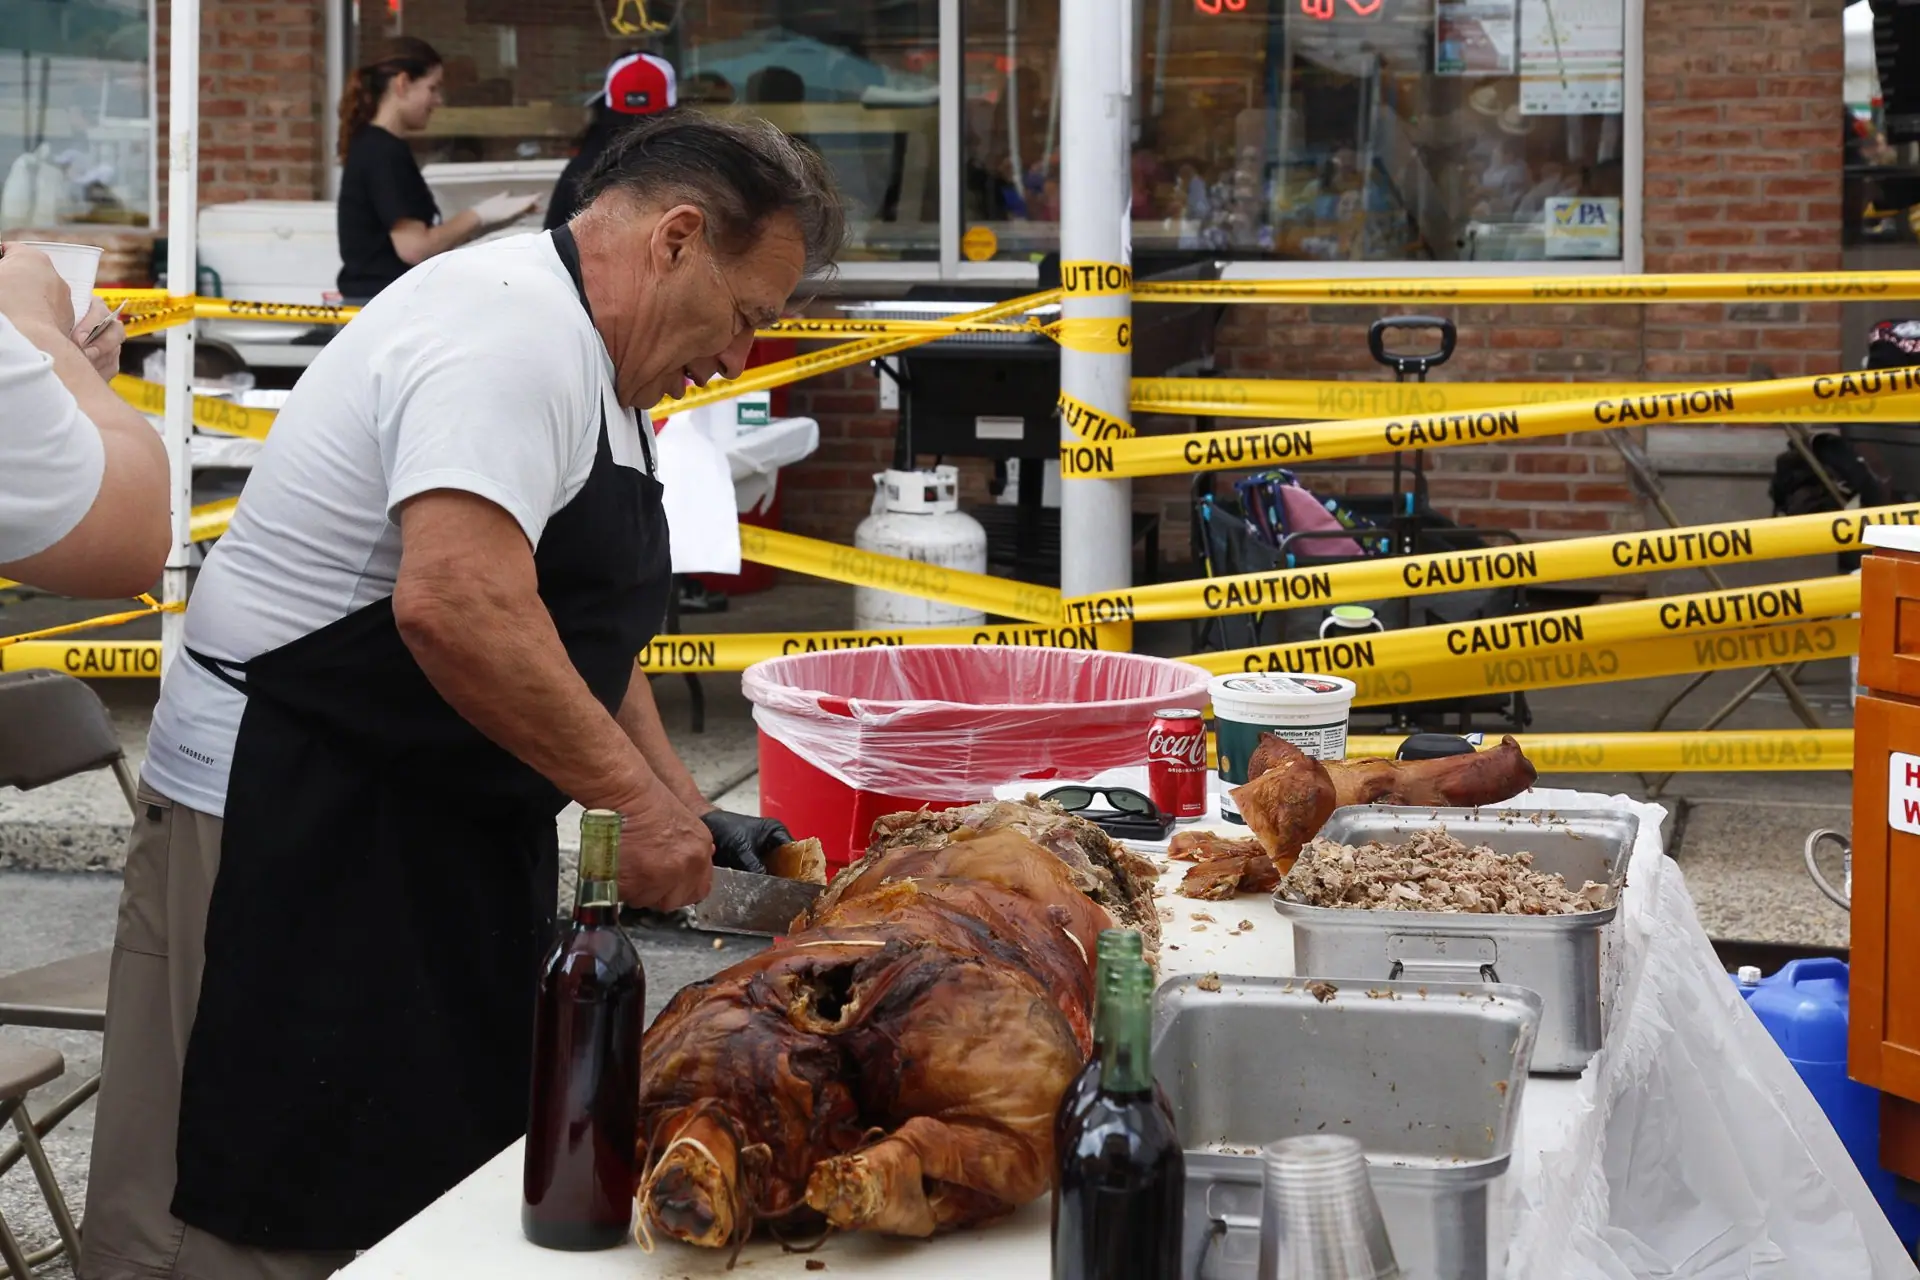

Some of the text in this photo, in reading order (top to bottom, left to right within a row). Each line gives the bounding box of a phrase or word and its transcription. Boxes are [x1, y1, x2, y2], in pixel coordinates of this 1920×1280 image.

[1579, 203, 1608, 225] PA
[1064, 265, 1132, 291] UTION
[1061, 446, 1114, 473] TION
[1184, 430, 1313, 465] CAUTION
[1385, 411, 1519, 446] CAUTION
[1594, 388, 1735, 424] CAUTION
[1203, 572, 1332, 610] CAUTION
[1403, 550, 1537, 588] CAUTION
[1612, 528, 1753, 568] CAUTION
[1244, 588, 1804, 674] CAUTION CAUTION CAUTION
[65, 648, 161, 671] CAUTIO
[638, 642, 715, 667] UTION
[1275, 730, 1303, 738] Nutrition
